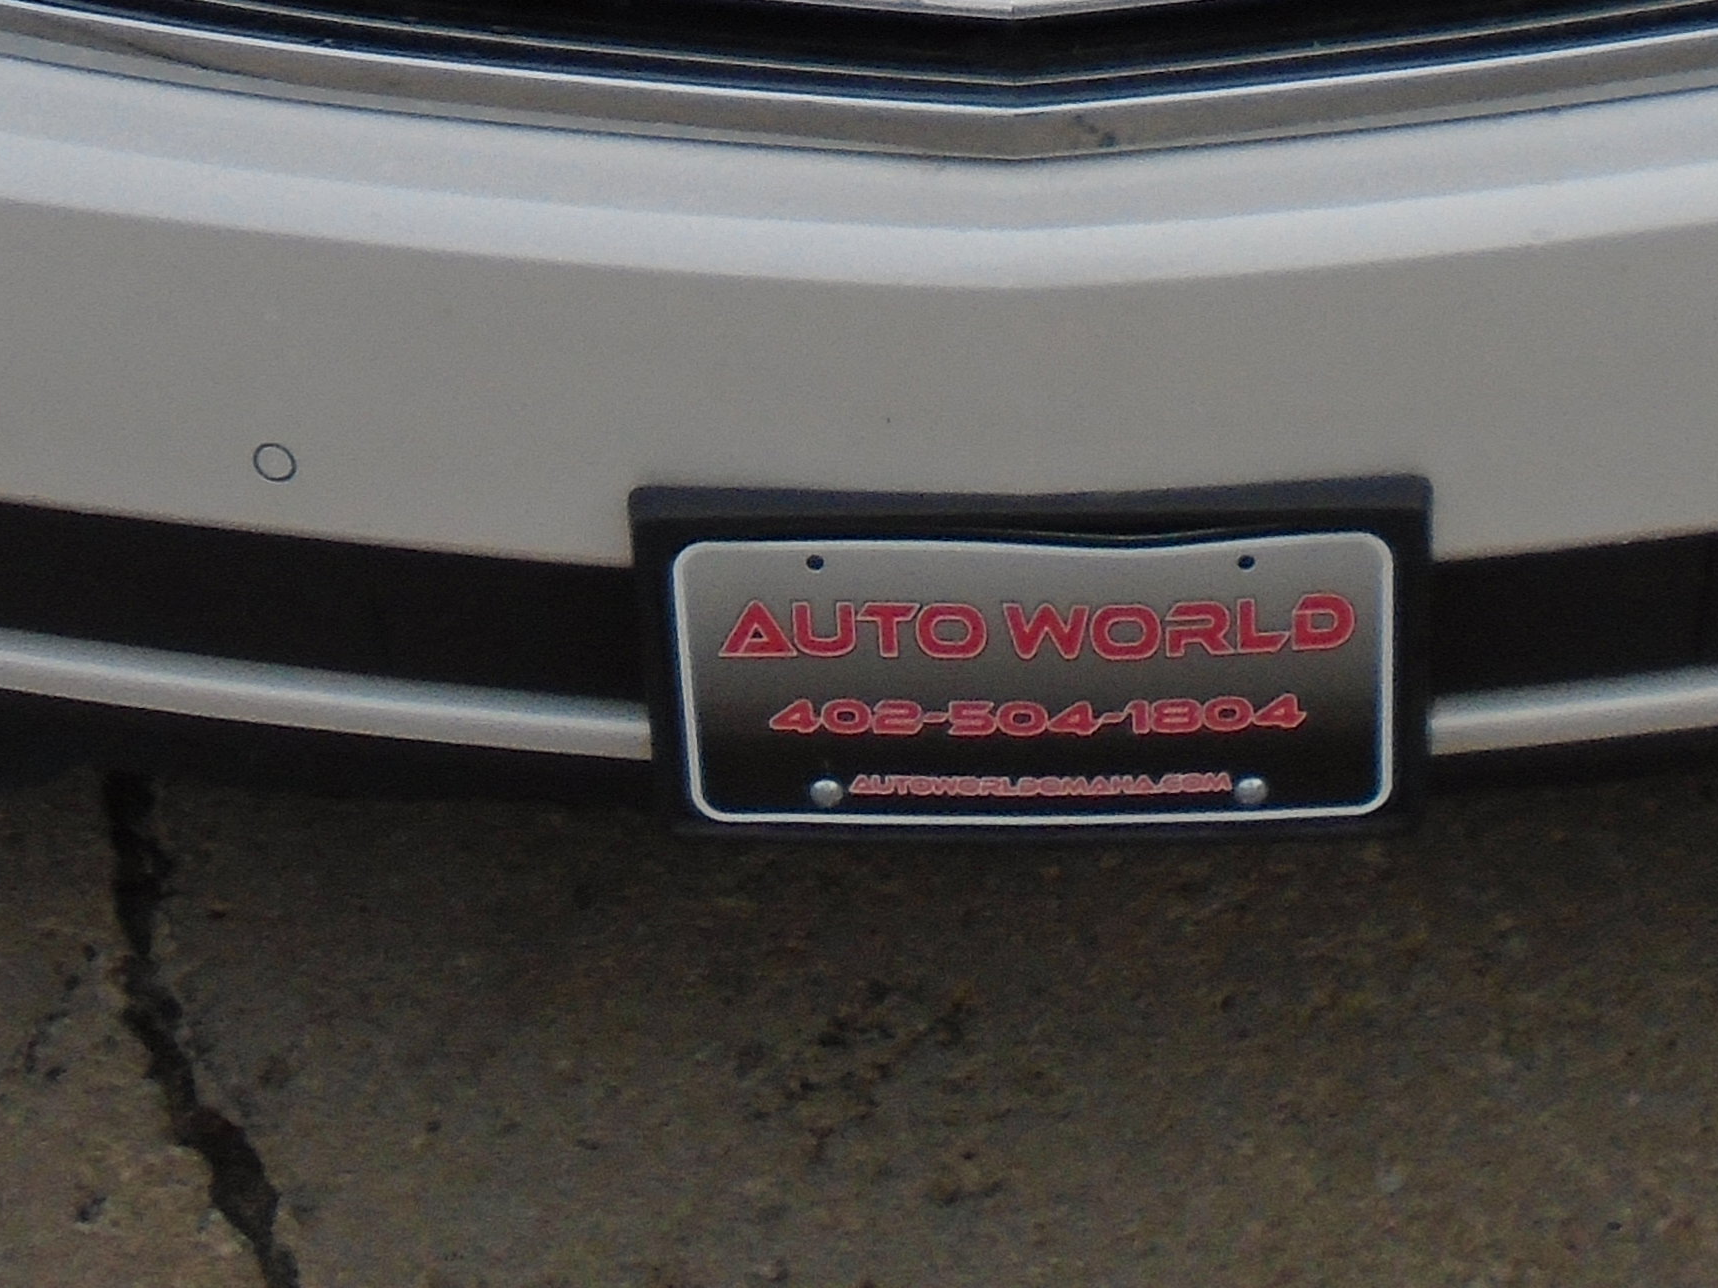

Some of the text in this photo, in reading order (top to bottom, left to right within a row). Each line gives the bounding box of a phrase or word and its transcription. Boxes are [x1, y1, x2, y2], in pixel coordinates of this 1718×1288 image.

[718, 592, 1357, 661] AUTO WORLD
[768, 693, 1308, 737] 402-504-1804
[848, 772, 1232, 798] AUTOWORLDOMAHA.COM
